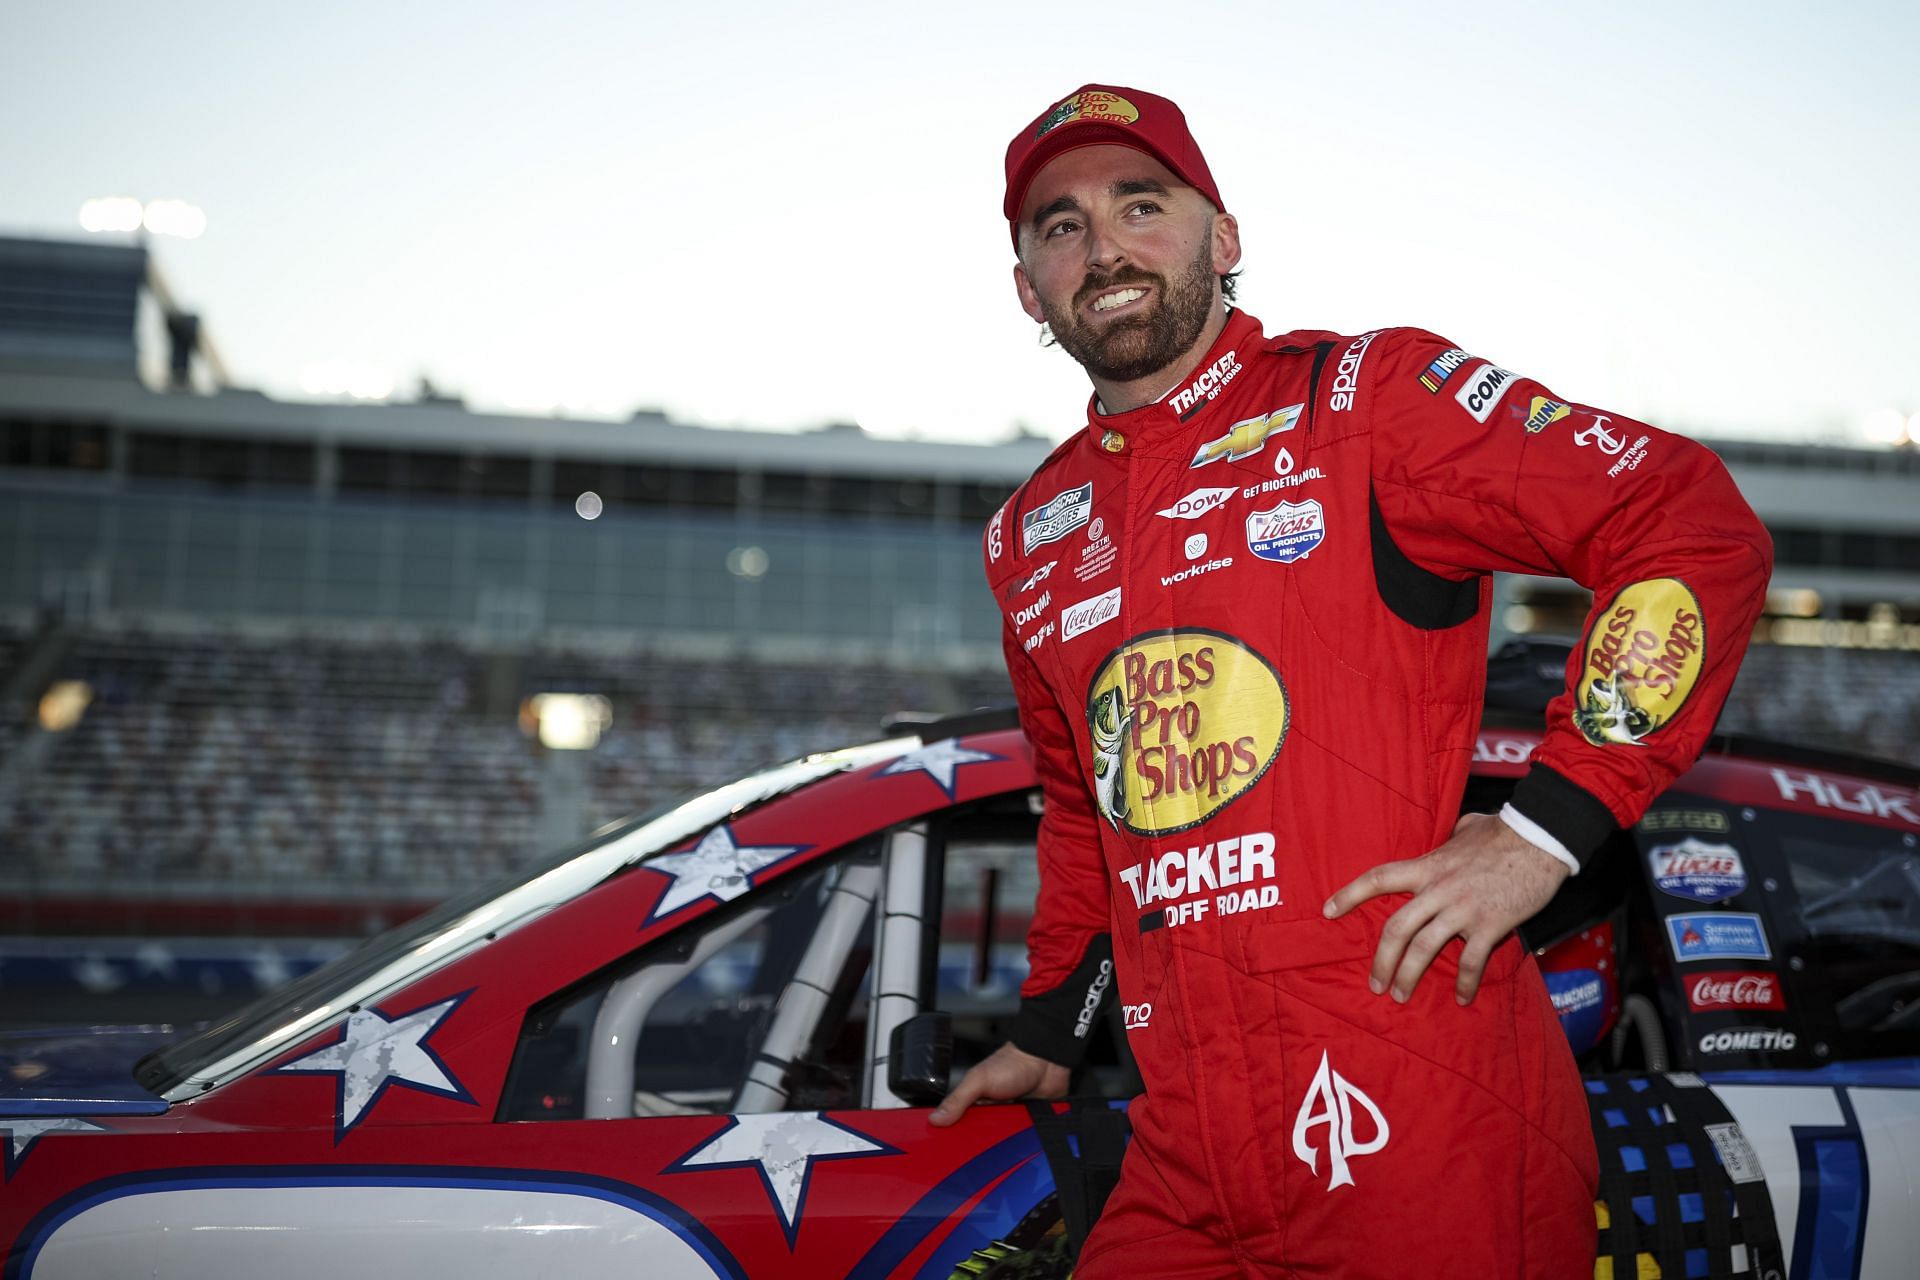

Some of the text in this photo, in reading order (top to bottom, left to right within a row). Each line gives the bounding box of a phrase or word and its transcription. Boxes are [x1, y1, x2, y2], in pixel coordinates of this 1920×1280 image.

[1075, 92, 1121, 105] Bass
[1077, 102, 1109, 113] Pro
[1079, 112, 1132, 124] Shops
[1435, 349, 1473, 374] NAS
[1168, 350, 1236, 416] TRACKER
[1220, 363, 1243, 387] ROAD
[1207, 384, 1223, 401] OFF
[1627, 450, 1648, 471] CAMO
[1043, 490, 1082, 519] NASCAR
[1243, 486, 1261, 499] GET
[1030, 507, 1080, 541] CUP SERIES
[1257, 514, 1317, 540] LUCAS
[1081, 533, 1110, 557] BREZTRI
[1254, 532, 1321, 552] OIL PRODUCTS
[1279, 547, 1299, 557] INC.
[1160, 557, 1234, 586] workrise
[1063, 592, 1120, 637] Coca-Cola
[1590, 605, 1636, 679] Bass
[1643, 607, 1699, 700] Shops
[1615, 630, 1660, 682] Pro
[1123, 646, 1215, 703] Bass
[1130, 700, 1201, 750] Pro
[1136, 736, 1258, 801] Shops
[1663, 856, 1736, 876] LUCAS
[1165, 885, 1280, 928] OFF ROAD
[1073, 959, 1113, 1039] sparco
[1699, 1030, 1797, 1053] COMETIC
